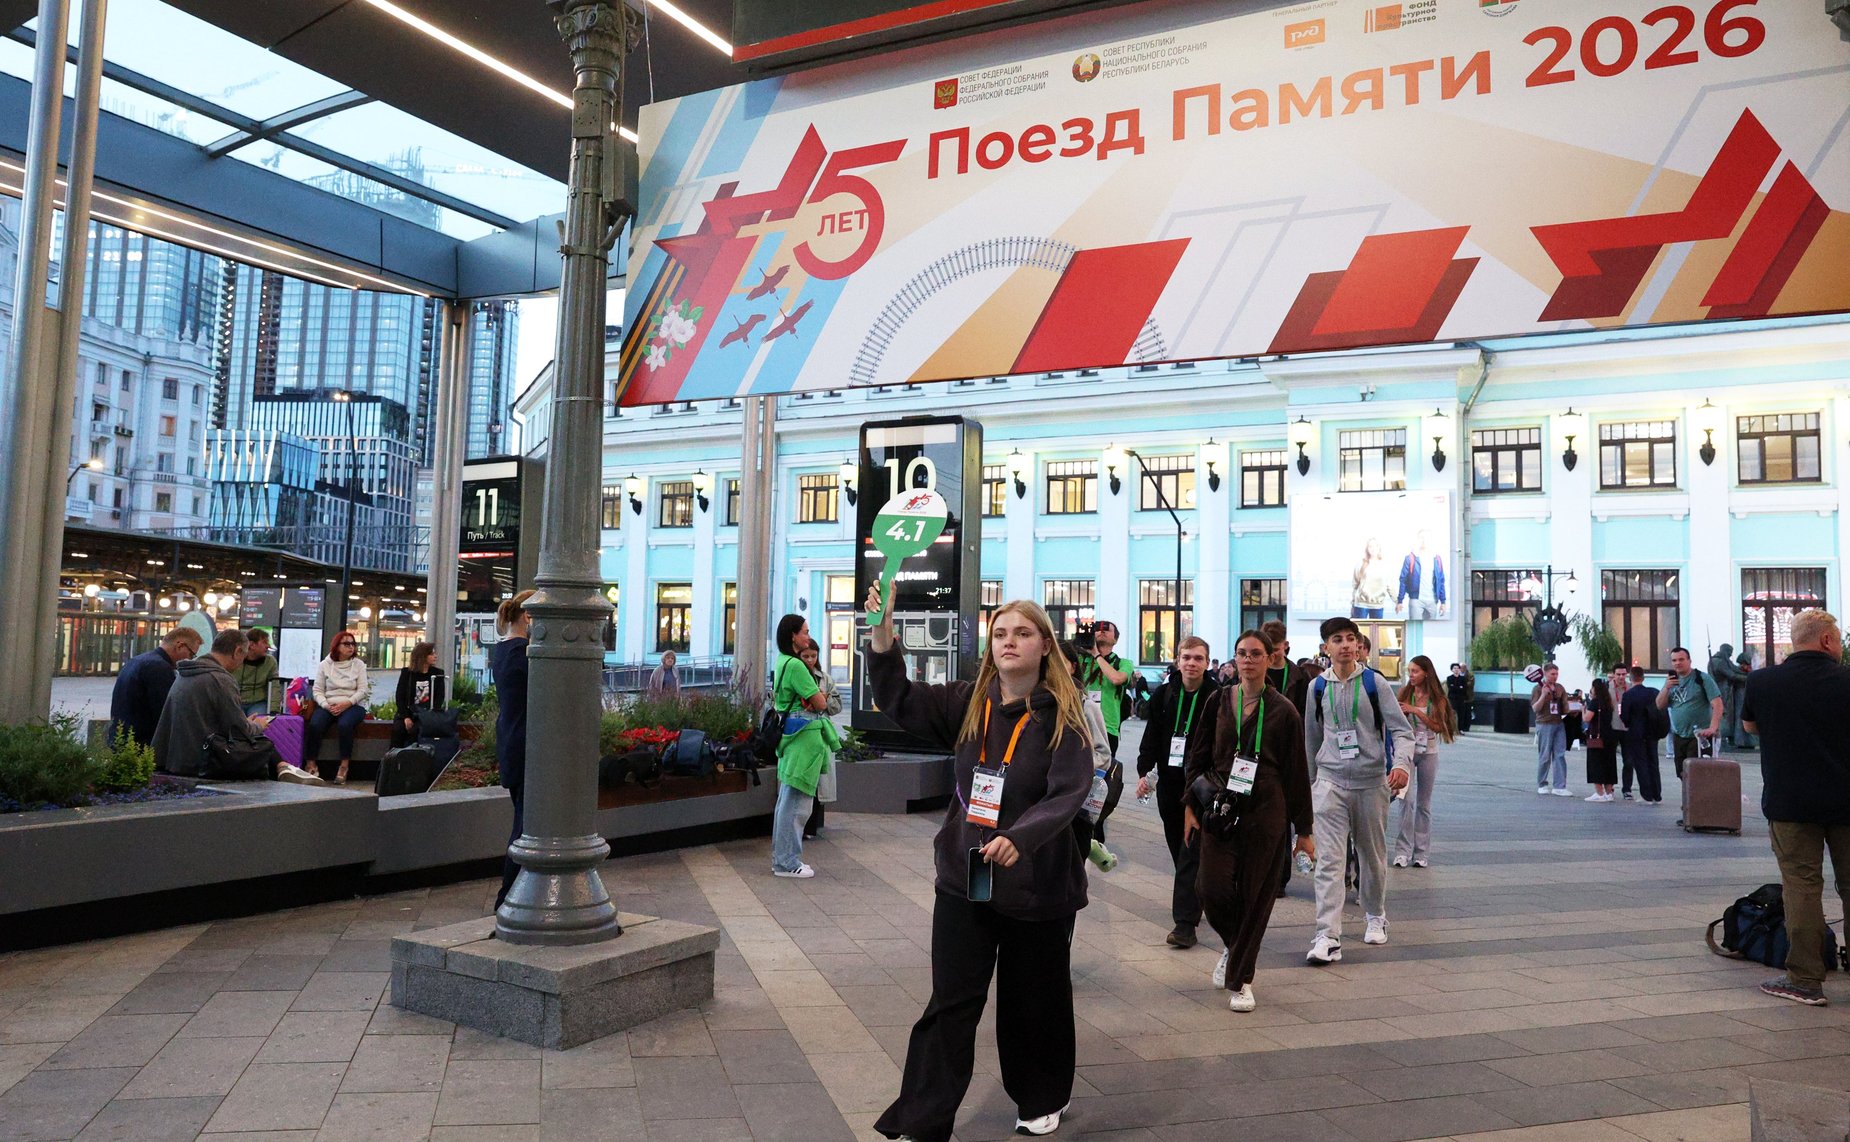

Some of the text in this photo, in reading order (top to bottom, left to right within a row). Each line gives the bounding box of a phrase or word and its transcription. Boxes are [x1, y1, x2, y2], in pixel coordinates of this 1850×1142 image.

[1102, 41, 1208, 68] НАЦИОНАЛЬНОГО СОБРАНИЯ
[1103, 36, 1175, 57] СОВЕТ РЕСПУБЛИКИ
[960, 65, 1022, 84] СОВЕТ ФЕДЕРАЦИИ
[1102, 56, 1190, 79] РЕСПУБЛИКИ БЕЛАРУСЬ
[927, 0, 1766, 179] Поезд Памяти 2026
[959, 70, 1049, 94] ФЕДЕРАЛЬНОГО СОБРАНИЯ
[959, 82, 1046, 105] РОССИЙСКОЙ ФЕДЕРАЦИИ
[816, 209, 869, 237] ЛЕТ
[884, 456, 937, 500] 10
[476, 488, 499, 526] 11
[467, 531, 485, 541] Путь
[489, 530, 505, 539] Track
[885, 520, 926, 541] 4.1
